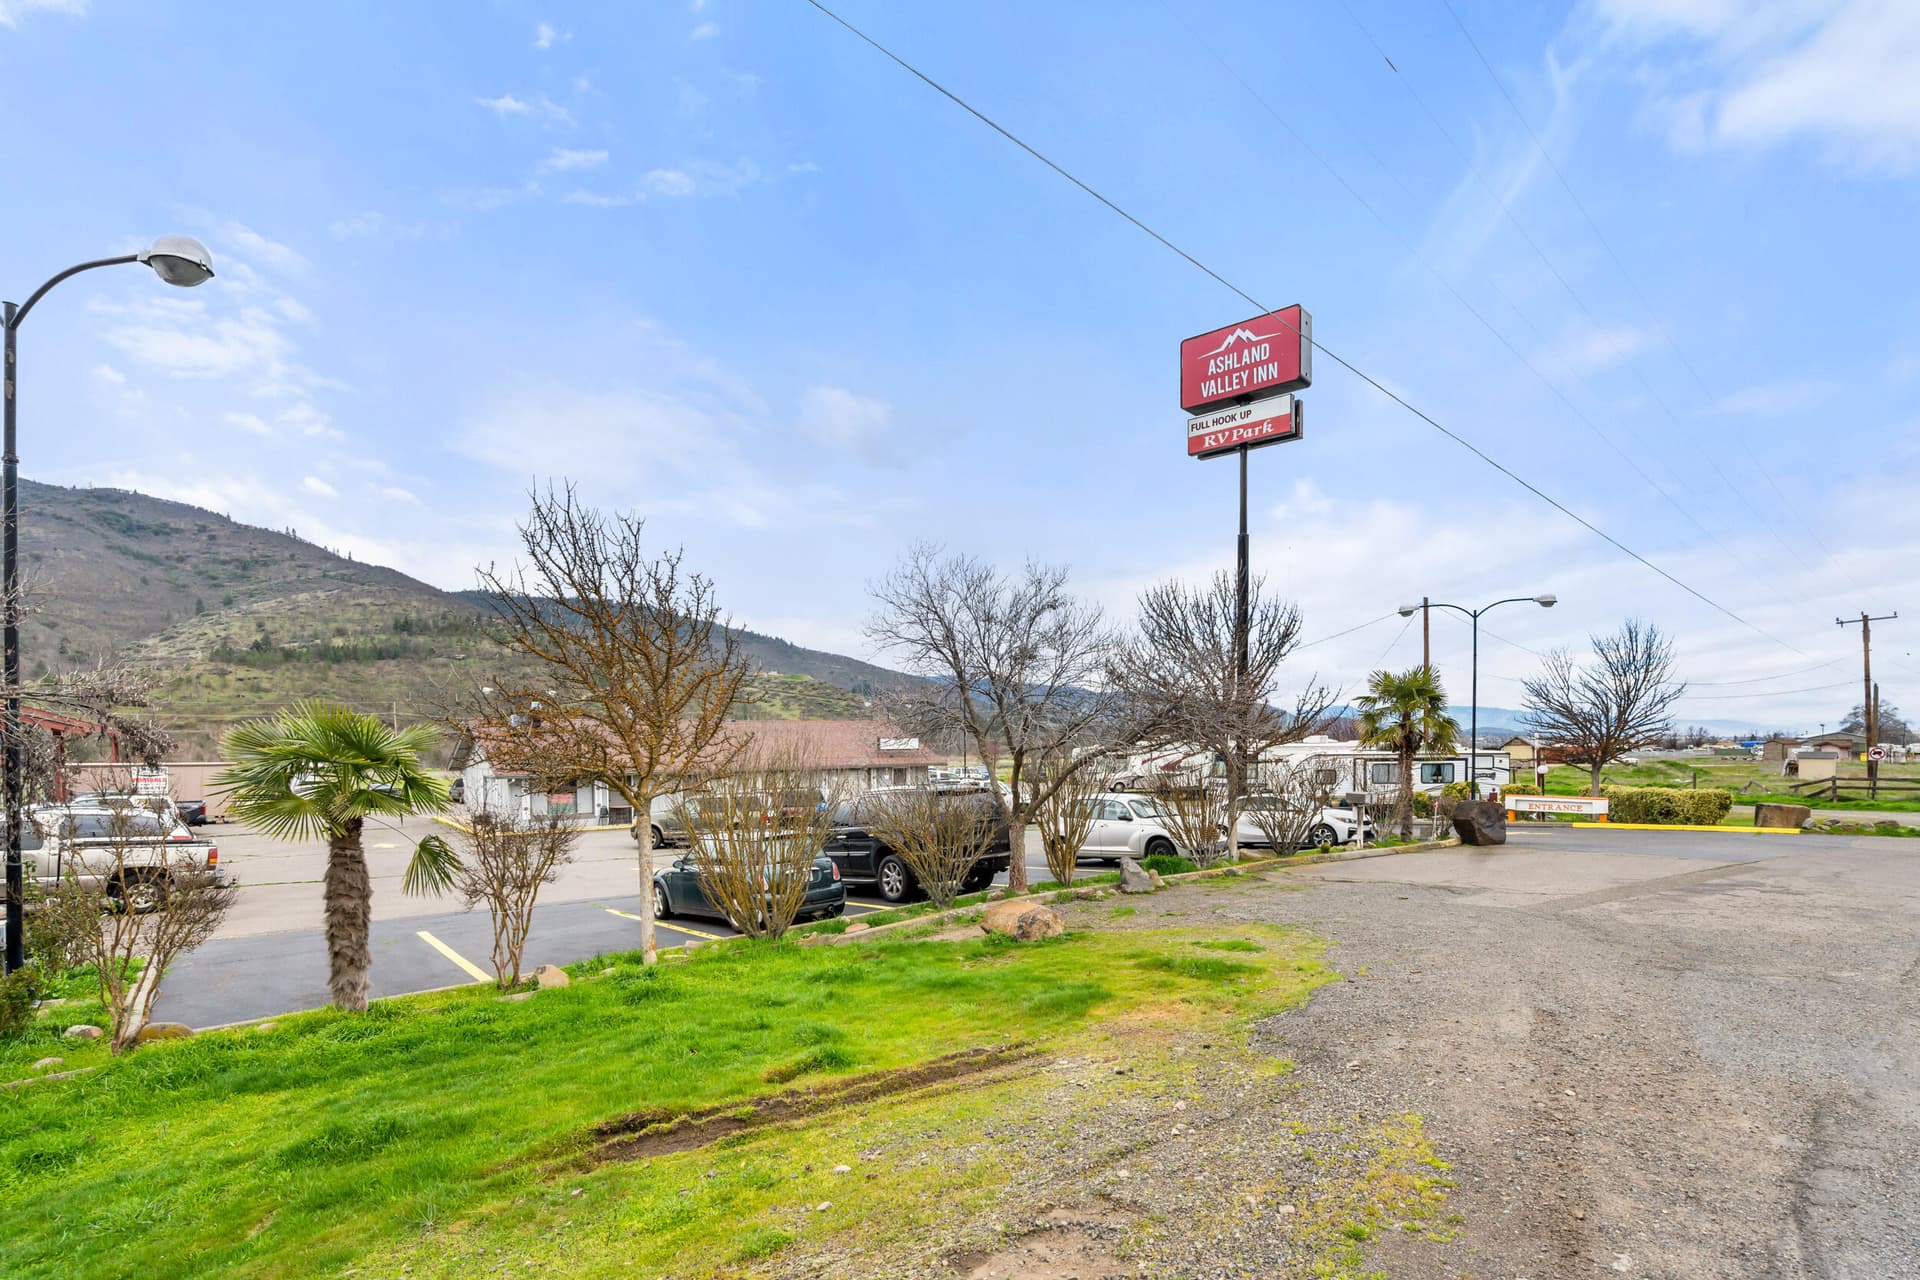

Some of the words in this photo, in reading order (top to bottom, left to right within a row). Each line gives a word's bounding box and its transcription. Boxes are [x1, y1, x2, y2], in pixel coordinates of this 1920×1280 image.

[1208, 343, 1269, 376] ASHLAND
[1201, 370, 1249, 397] VALLEY
[1253, 362, 1278, 384] INN
[1191, 422, 1210, 432] FULL
[1212, 415, 1237, 426] HOOK
[1240, 410, 1252, 420] UP
[1203, 431, 1230, 448] RV
[1232, 420, 1274, 441] Park
[1528, 803, 1583, 812] ENTRANCE
